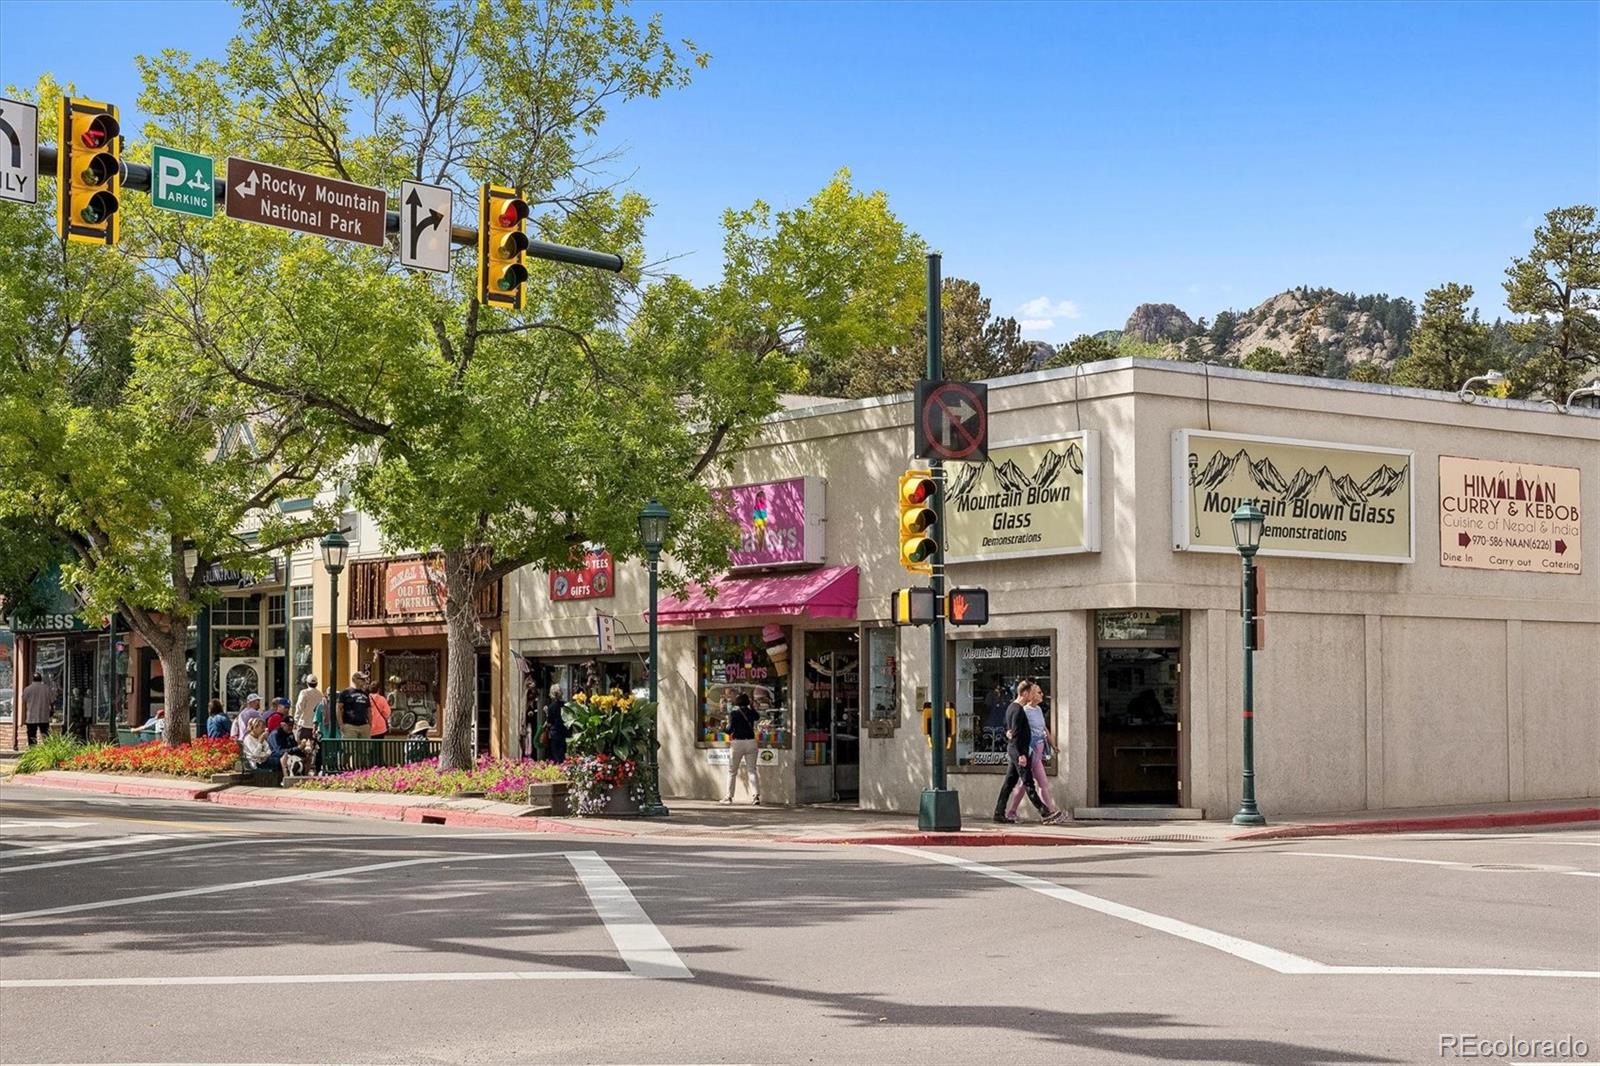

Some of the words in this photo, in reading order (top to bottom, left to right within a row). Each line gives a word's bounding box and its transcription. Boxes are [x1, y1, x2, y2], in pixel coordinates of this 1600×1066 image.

[0, 171, 28, 193] LY
[261, 173, 307, 202] Rocky
[315, 184, 380, 214] Mountain
[260, 199, 322, 227] National
[330, 213, 362, 235] Park
[1464, 471, 1556, 503] HIMALAYAN
[957, 490, 1022, 512] Mountain
[1026, 486, 1071, 505] Blown
[1203, 491, 1287, 517] Moutain
[1292, 498, 1344, 521] Blown
[1349, 501, 1396, 524] Glass
[1442, 496, 1501, 515] CURRY
[1507, 501, 1518, 517] &
[1525, 502, 1579, 521] KEBOB
[992, 512, 1032, 531] Glass
[1442, 513, 1484, 530] Cuisine
[1487, 517, 1499, 530] of
[1502, 518, 1536, 534] Nepal
[1539, 520, 1548, 534] &
[1551, 522, 1579, 537] India
[982, 532, 1042, 547] Demonstrations
[592, 559, 609, 569] TEES
[1443, 552, 1462, 562] Dine
[1465, 553, 1473, 563] In
[1489, 556, 1514, 567] Carry
[1517, 559, 1532, 567] out
[1541, 559, 1580, 571] Catering
[577, 573, 584, 583] &
[397, 585, 413, 597] OLD
[570, 585, 591, 597] GIFTS
[16, 614, 74, 630] ERESS
[603, 617, 613, 651] OPEN
[962, 646, 1001, 660] Mountain
[1002, 645, 1029, 658] Blown
[1030, 644, 1051, 658] Glas
[725, 662, 768, 682] Flaors
